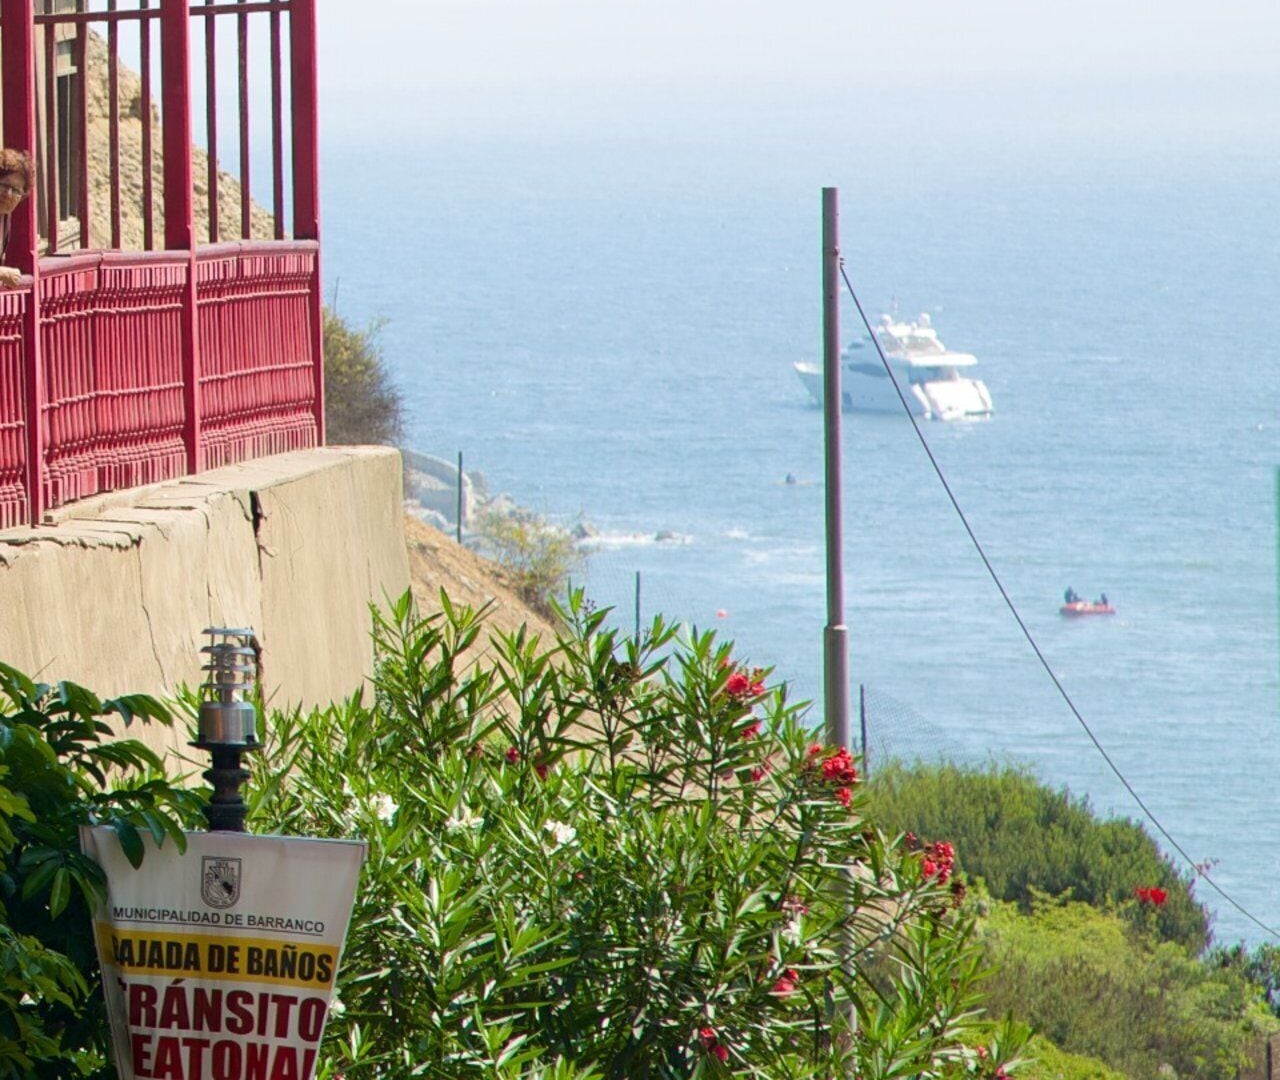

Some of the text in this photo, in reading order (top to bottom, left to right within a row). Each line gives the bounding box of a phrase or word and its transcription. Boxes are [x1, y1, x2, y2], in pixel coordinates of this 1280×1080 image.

[113, 906, 325, 933] MUNICIPALIDAD DE BARRANCO
[208, 944, 240, 974] DE
[247, 944, 332, 983] BAÑOS
[118, 977, 327, 1042] RÁNSITO
